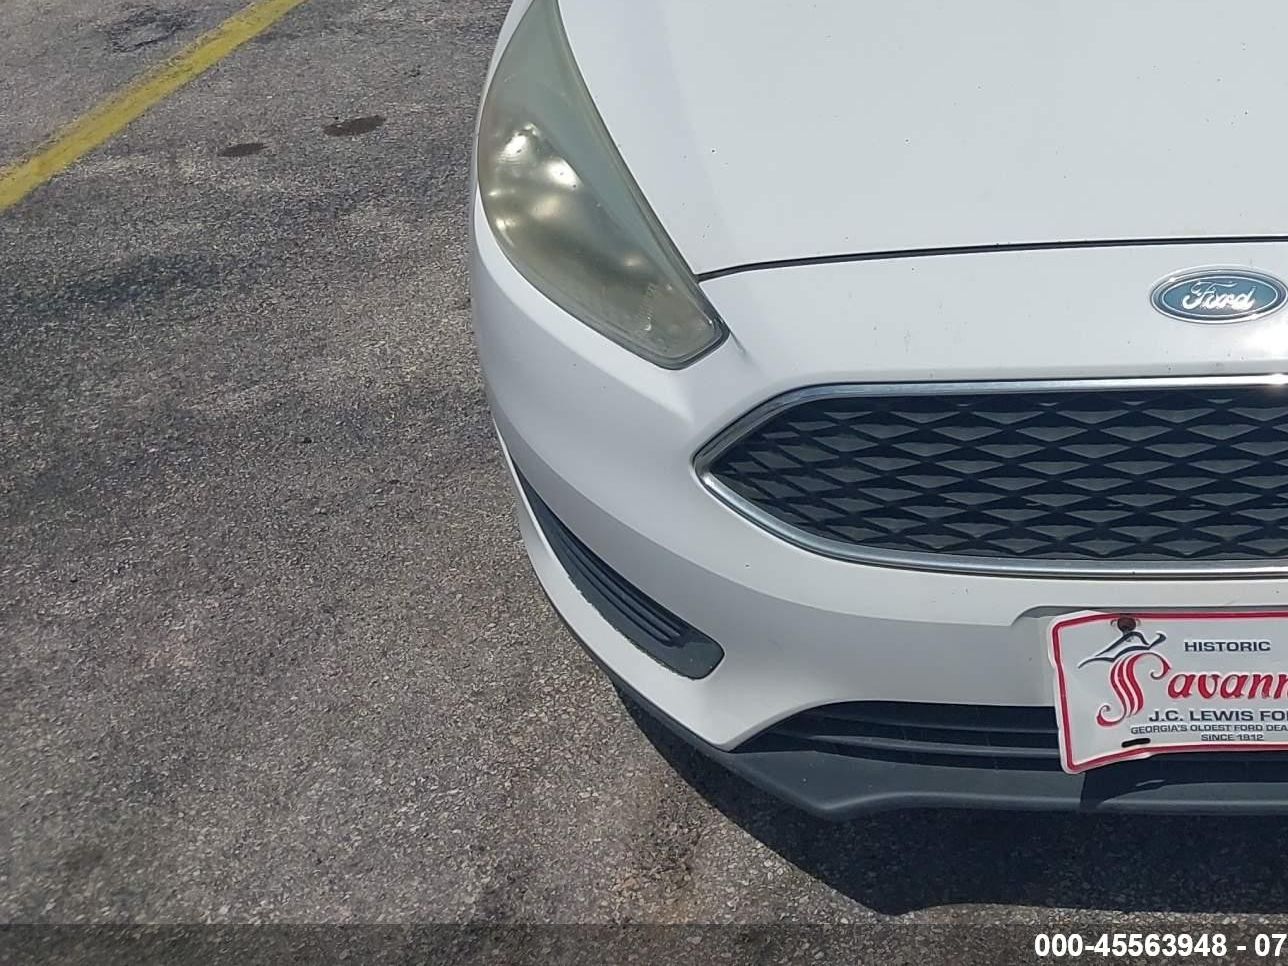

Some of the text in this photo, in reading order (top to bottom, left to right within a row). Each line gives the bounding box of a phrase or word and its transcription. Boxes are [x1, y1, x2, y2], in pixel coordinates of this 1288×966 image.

[1182, 280, 1257, 310] Ford
[1184, 641, 1271, 652] HISTORIC
[1148, 710, 1183, 722] J.C.
[1189, 710, 1254, 722] LEWIS
[1131, 724, 1187, 735] GEORGIA'S
[1190, 724, 1231, 732] OLDEST
[1234, 724, 1263, 732] FORD
[1201, 733, 1264, 742] SINCE 1912
